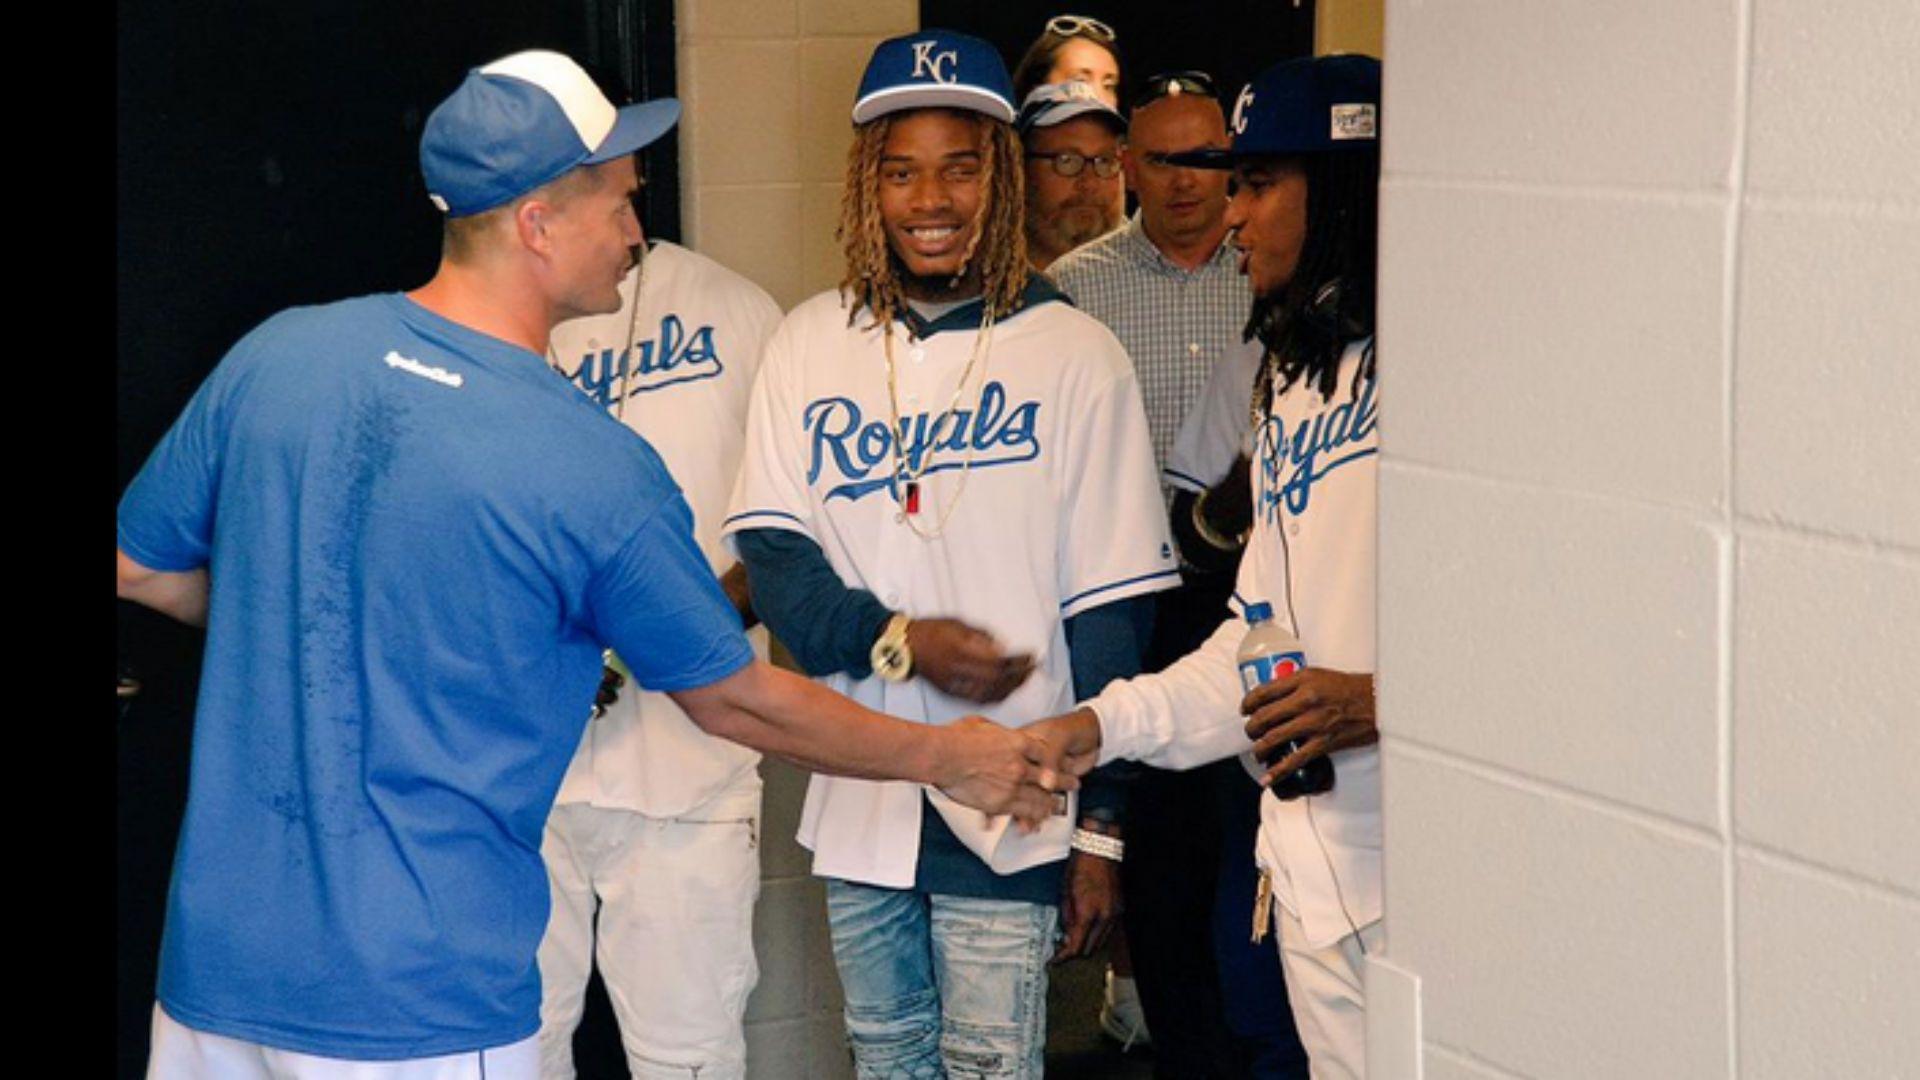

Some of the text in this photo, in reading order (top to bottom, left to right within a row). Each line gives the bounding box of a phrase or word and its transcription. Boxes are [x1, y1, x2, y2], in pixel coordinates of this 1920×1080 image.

[911, 40, 957, 84] KC
[1229, 83, 1256, 136] C
[562, 313, 721, 407] yals
[803, 381, 1041, 504] Royals
